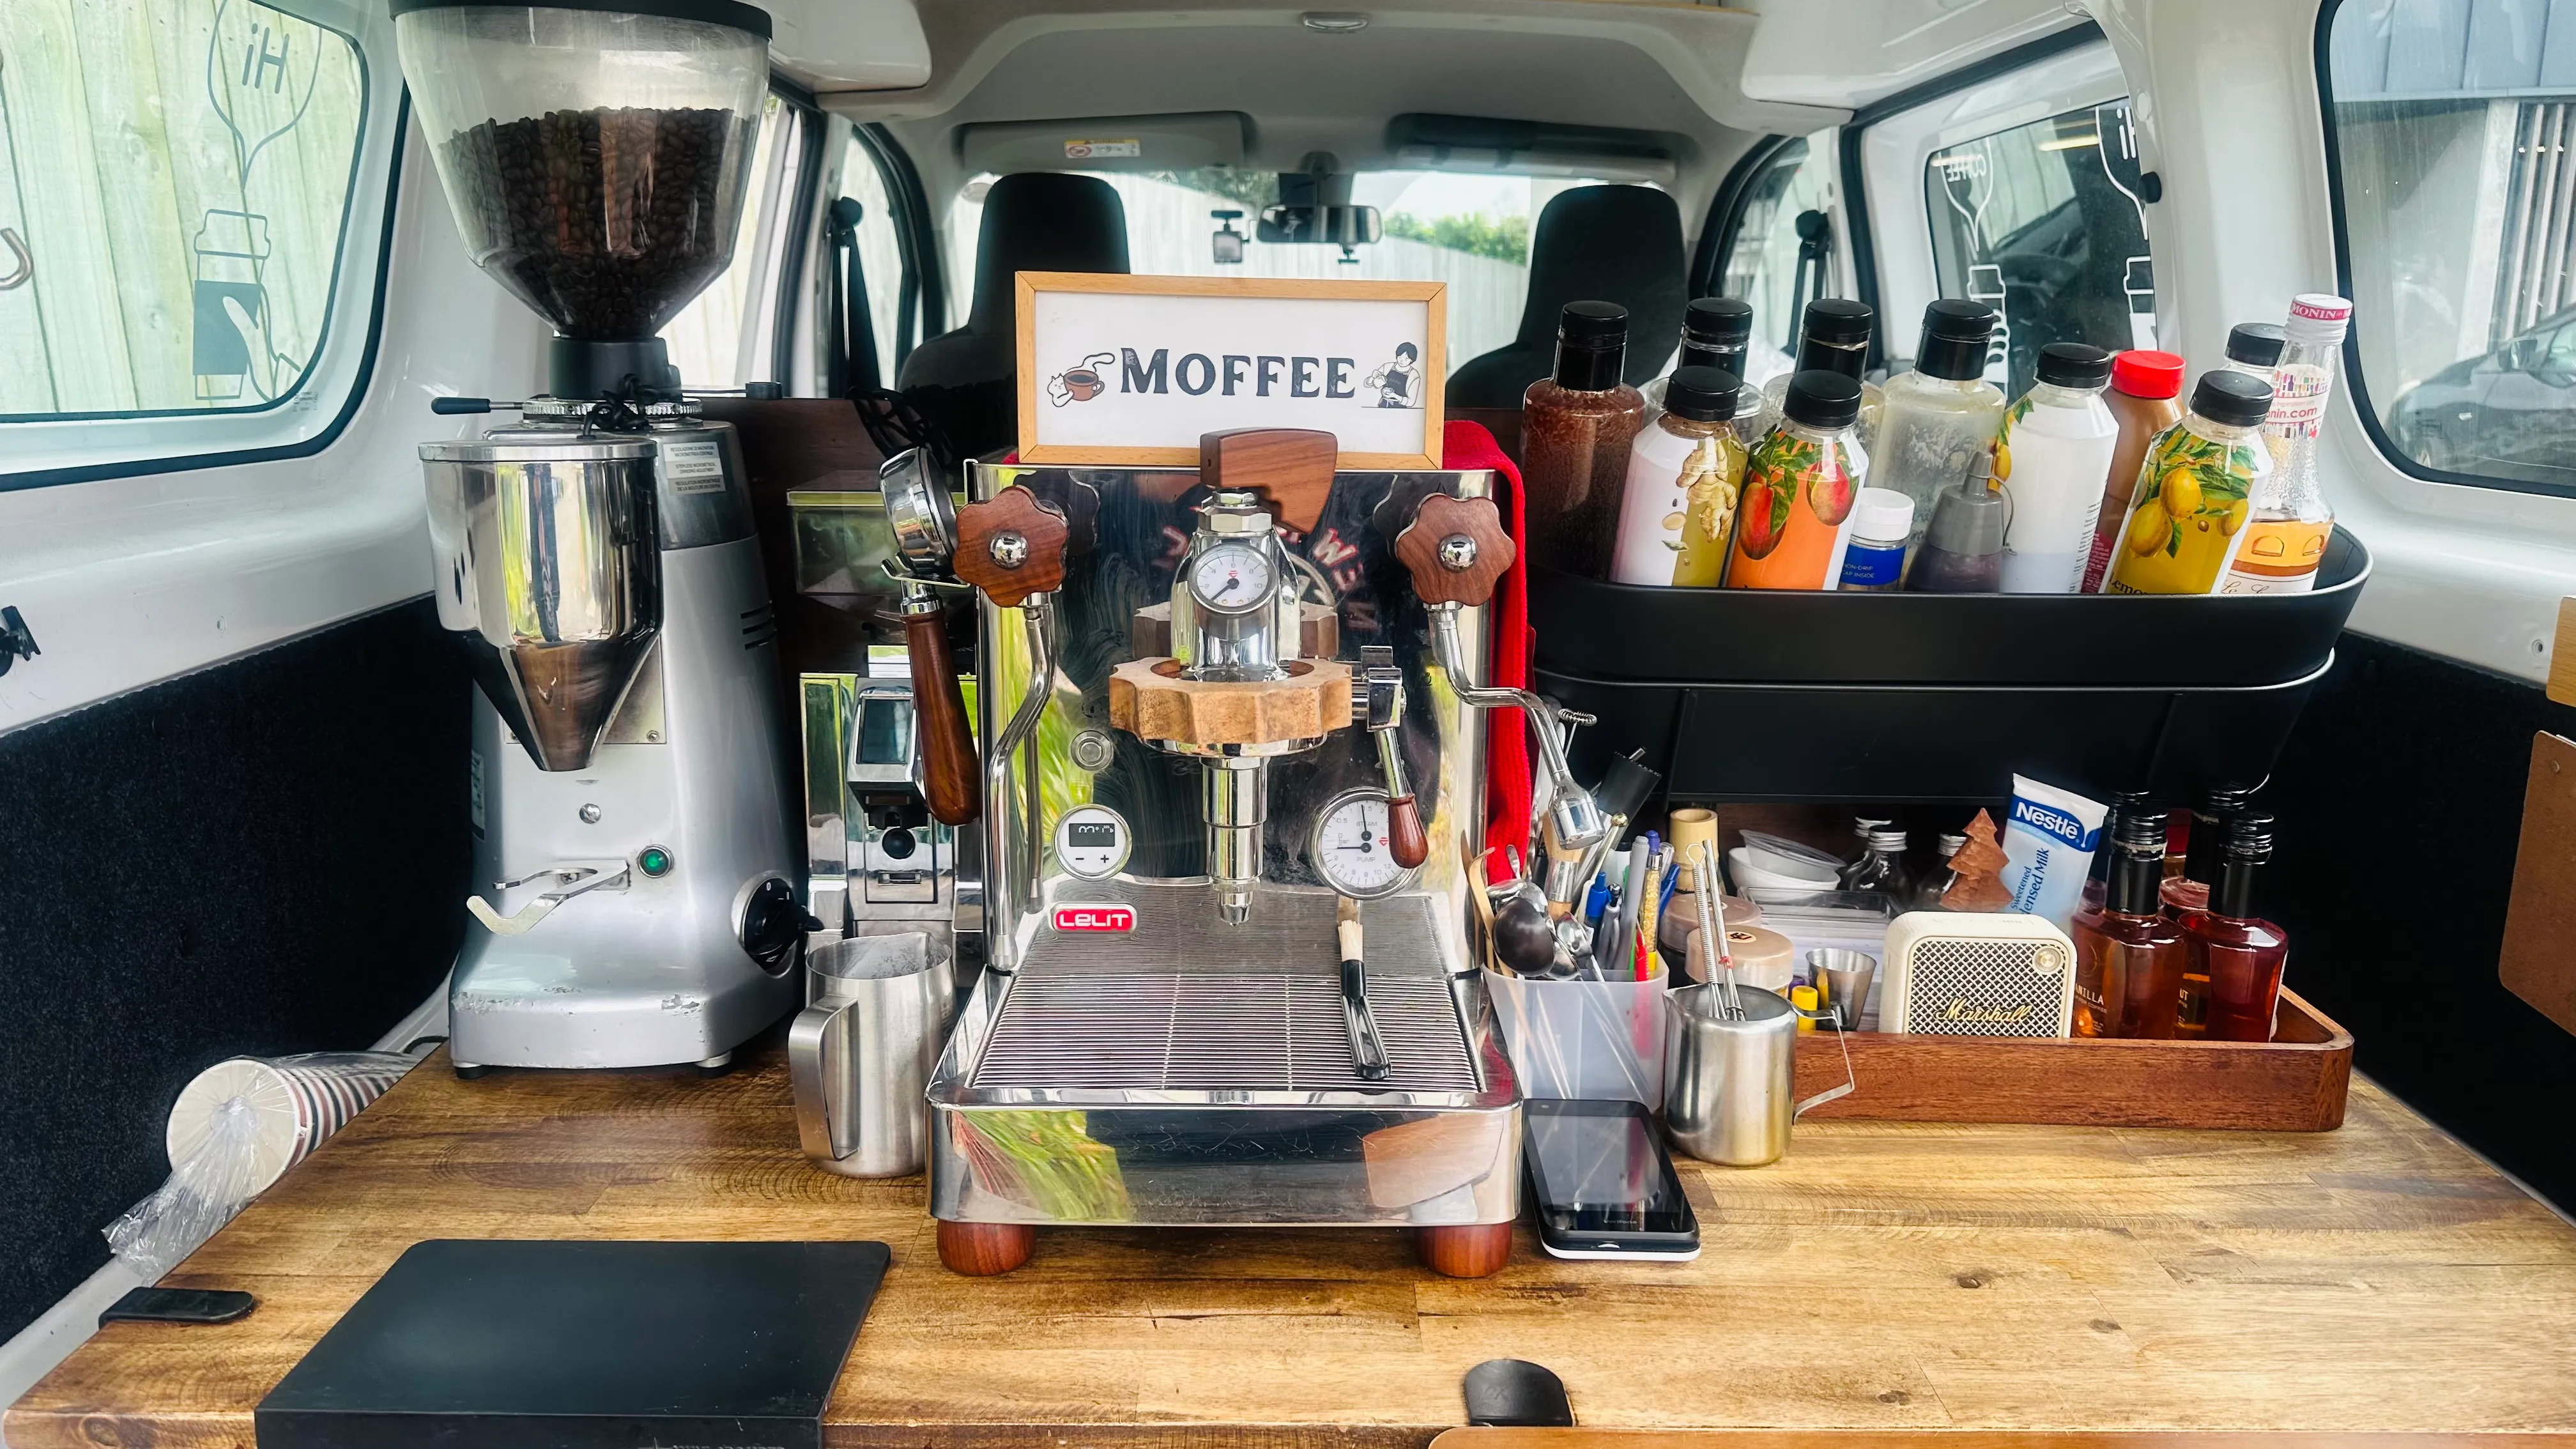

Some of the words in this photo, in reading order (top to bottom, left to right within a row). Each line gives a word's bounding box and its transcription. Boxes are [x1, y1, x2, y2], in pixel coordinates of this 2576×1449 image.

[2292, 303, 2337, 319] MONIN
[1121, 348, 1355, 398] MOFFEE
[2110, 572, 2148, 594] Lemo
[2034, 847, 2050, 875] Milk
[2011, 866, 2032, 910] Sweetened
[1935, 996, 2033, 1023] Marshall
